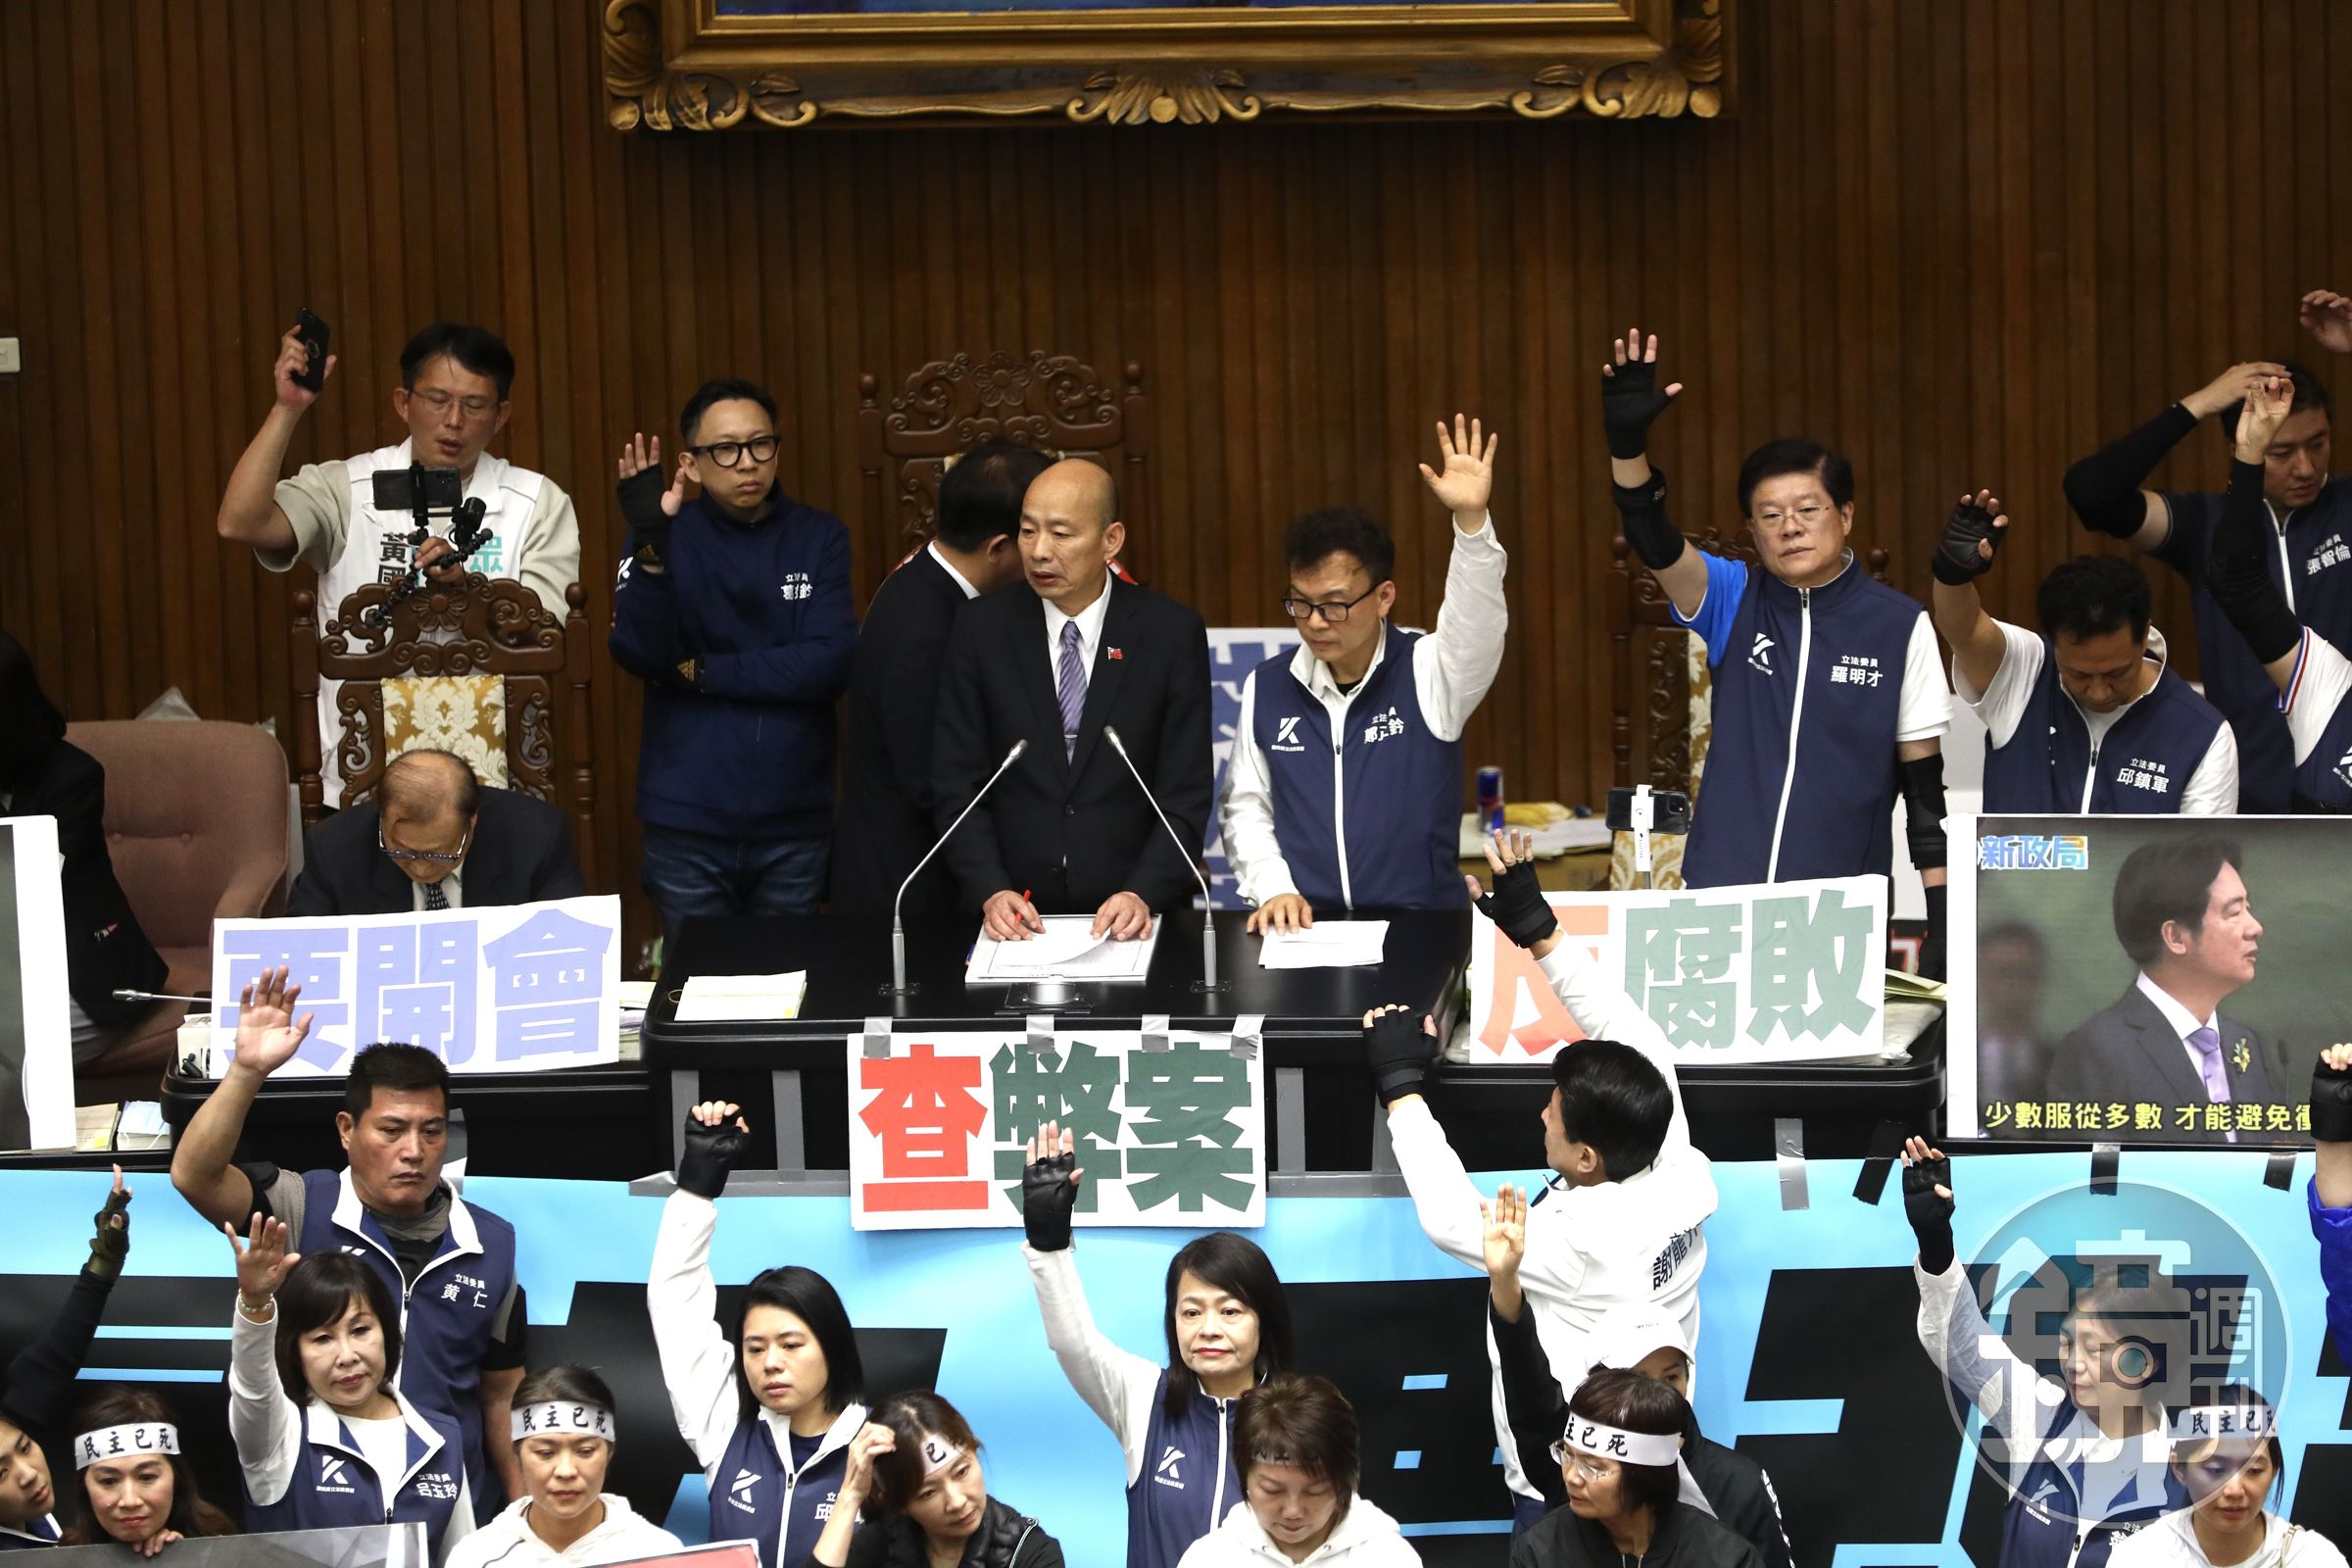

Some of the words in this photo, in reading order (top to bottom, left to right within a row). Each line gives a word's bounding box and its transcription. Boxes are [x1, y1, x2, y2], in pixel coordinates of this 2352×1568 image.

[1841, 655, 1879, 667] 立法委員
[1831, 665, 1884, 687] 羅明才
[2131, 758, 2166, 774] 立法委員
[2117, 767, 2170, 793] 邱鎮軍
[1979, 836, 2088, 870] 新政局
[220, 907, 612, 1071] 要開會
[858, 1041, 1256, 1213] 查弊案
[1984, 1102, 2162, 1131] 少數服從多數
[455, 1274, 485, 1290] 立法委員
[416, 1483, 459, 1499] 呂玉玲
